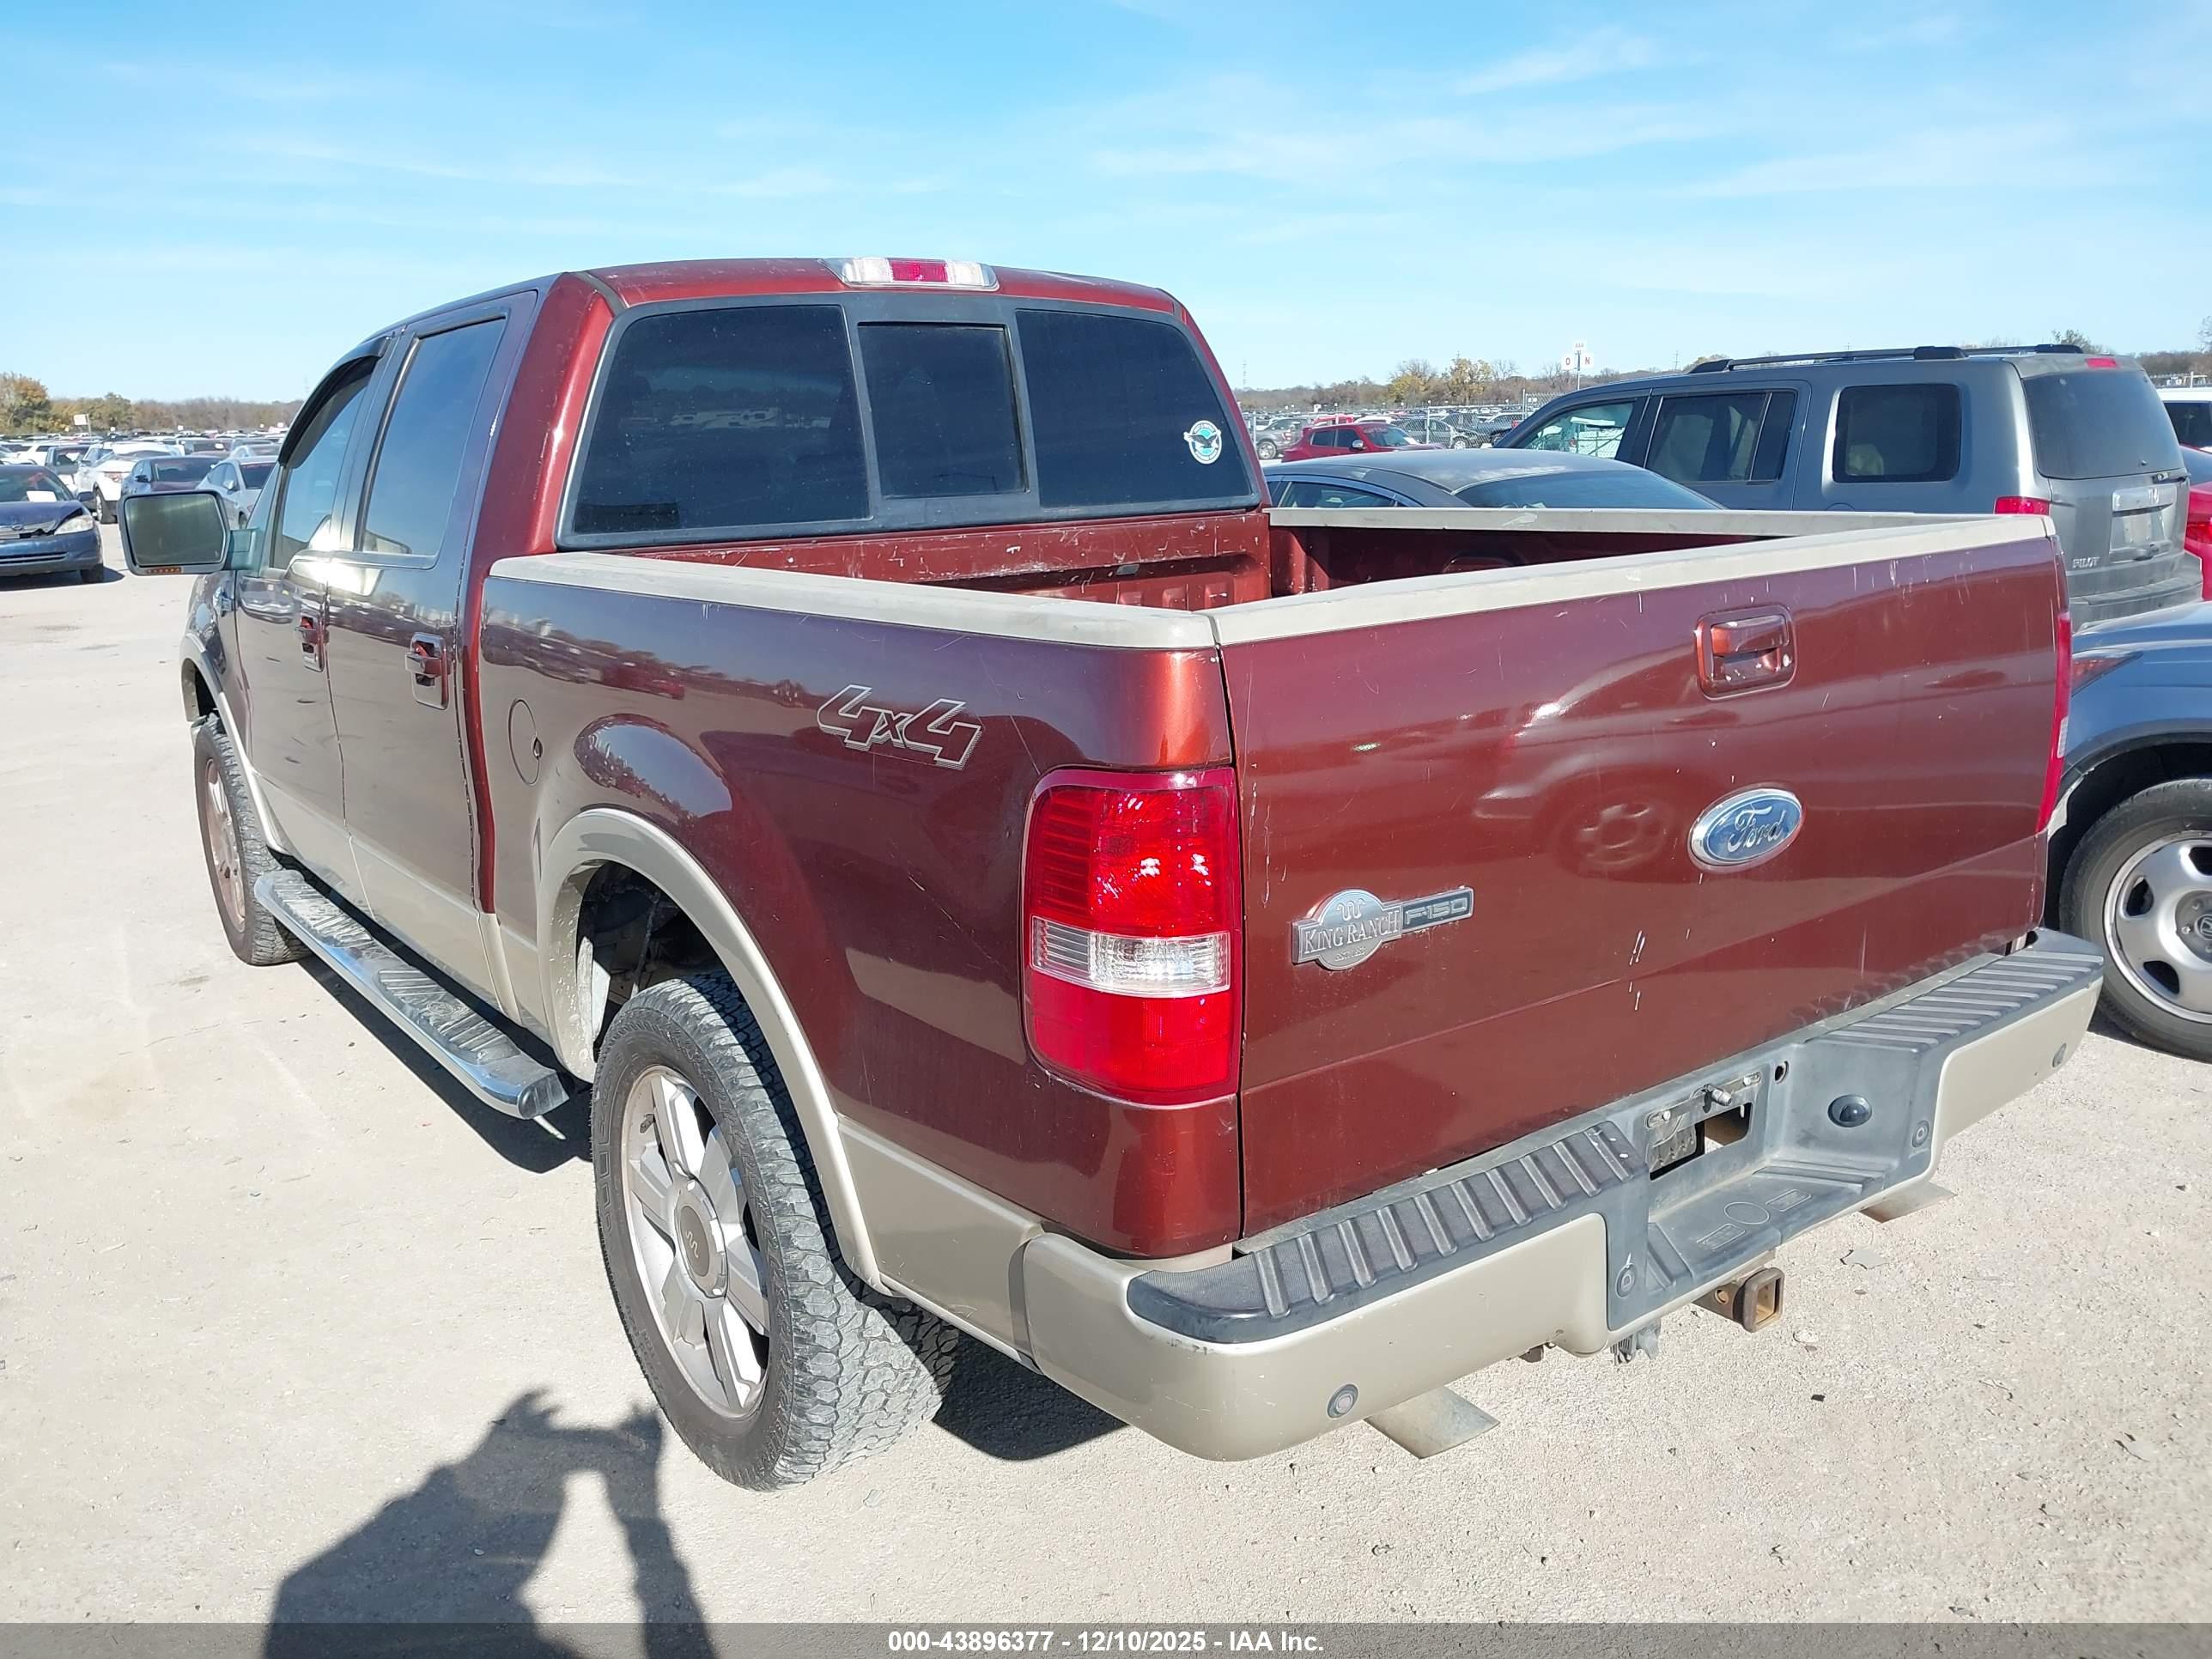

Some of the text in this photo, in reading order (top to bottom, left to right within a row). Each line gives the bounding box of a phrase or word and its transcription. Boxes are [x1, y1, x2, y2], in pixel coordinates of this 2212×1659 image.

[2072, 556, 2100, 568] PILOT
[817, 684, 985, 770] 4x4
[1727, 804, 1787, 853] Ford
[1304, 926, 1344, 955] KING
[1346, 910, 1401, 945] RANCH
[1405, 897, 1468, 926] F-150
